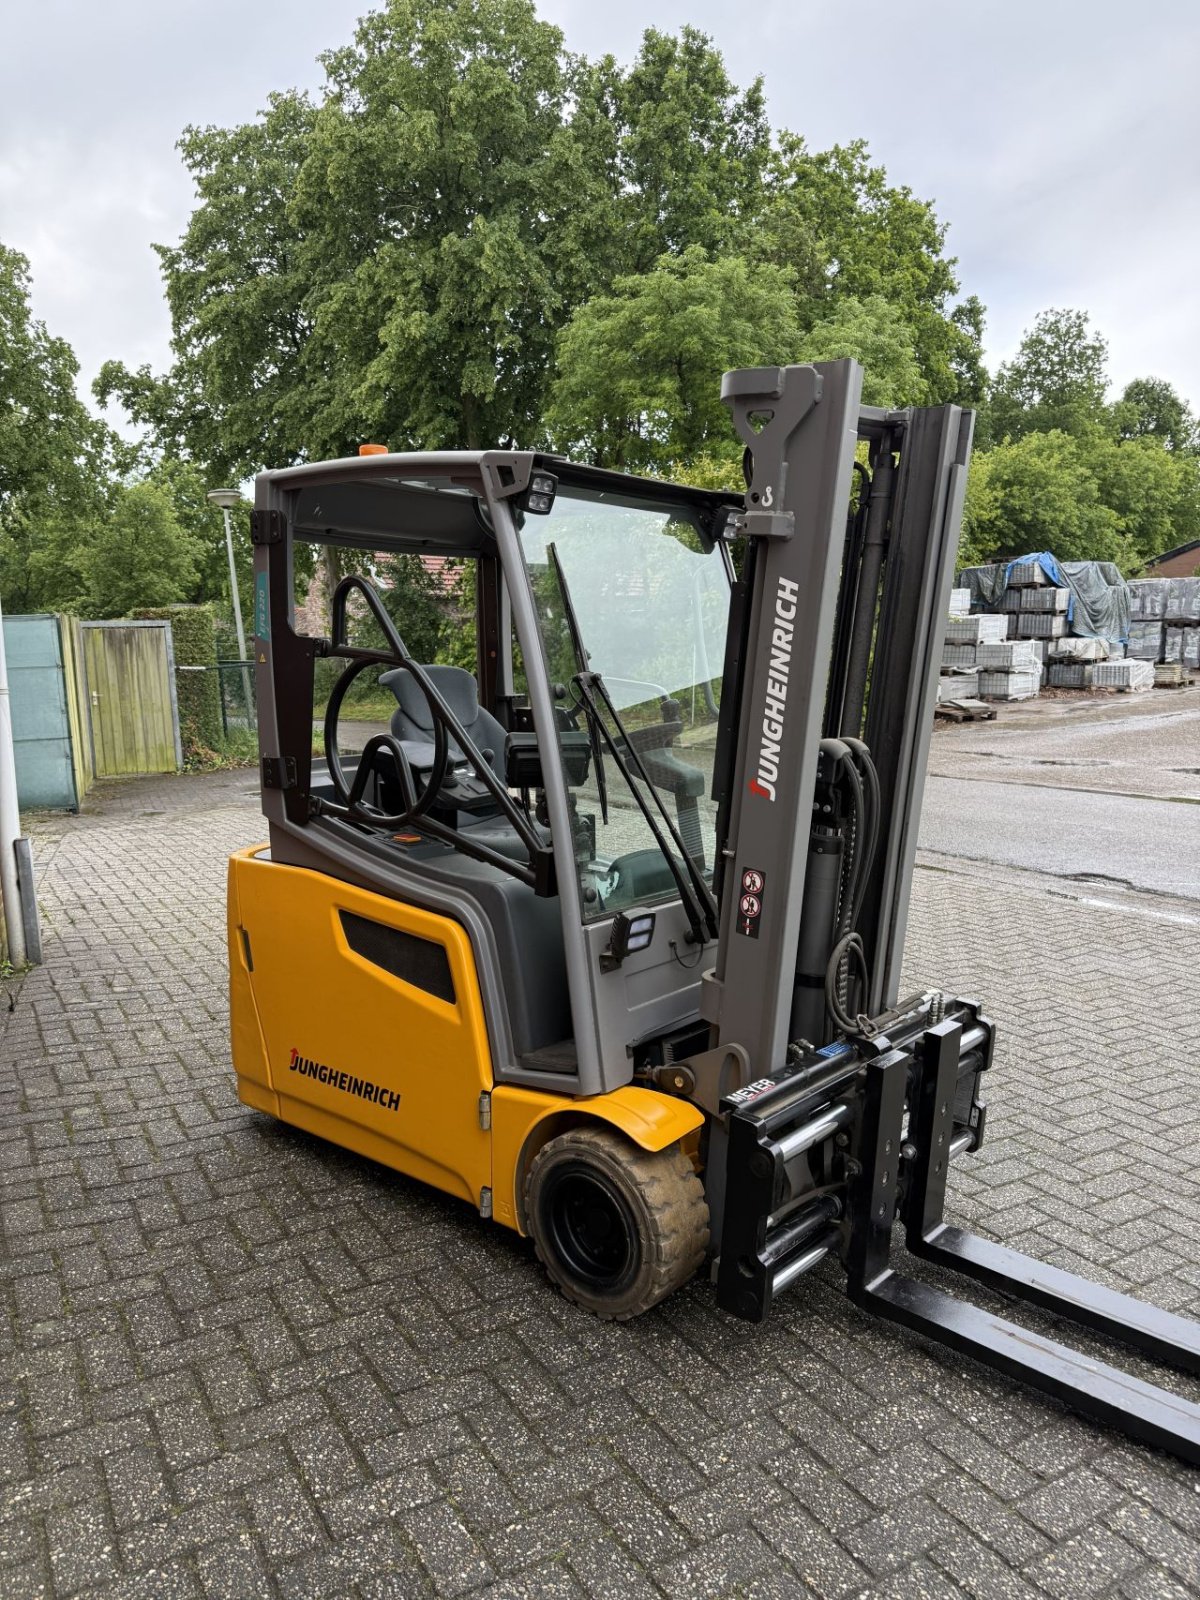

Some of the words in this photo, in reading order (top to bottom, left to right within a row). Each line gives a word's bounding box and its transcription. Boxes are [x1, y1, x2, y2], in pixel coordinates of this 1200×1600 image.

[755, 576, 799, 802] JUNGHEINRICH
[289, 1054, 401, 1111] JUNGHEINRICH
[726, 1078, 776, 1102] MEYER
